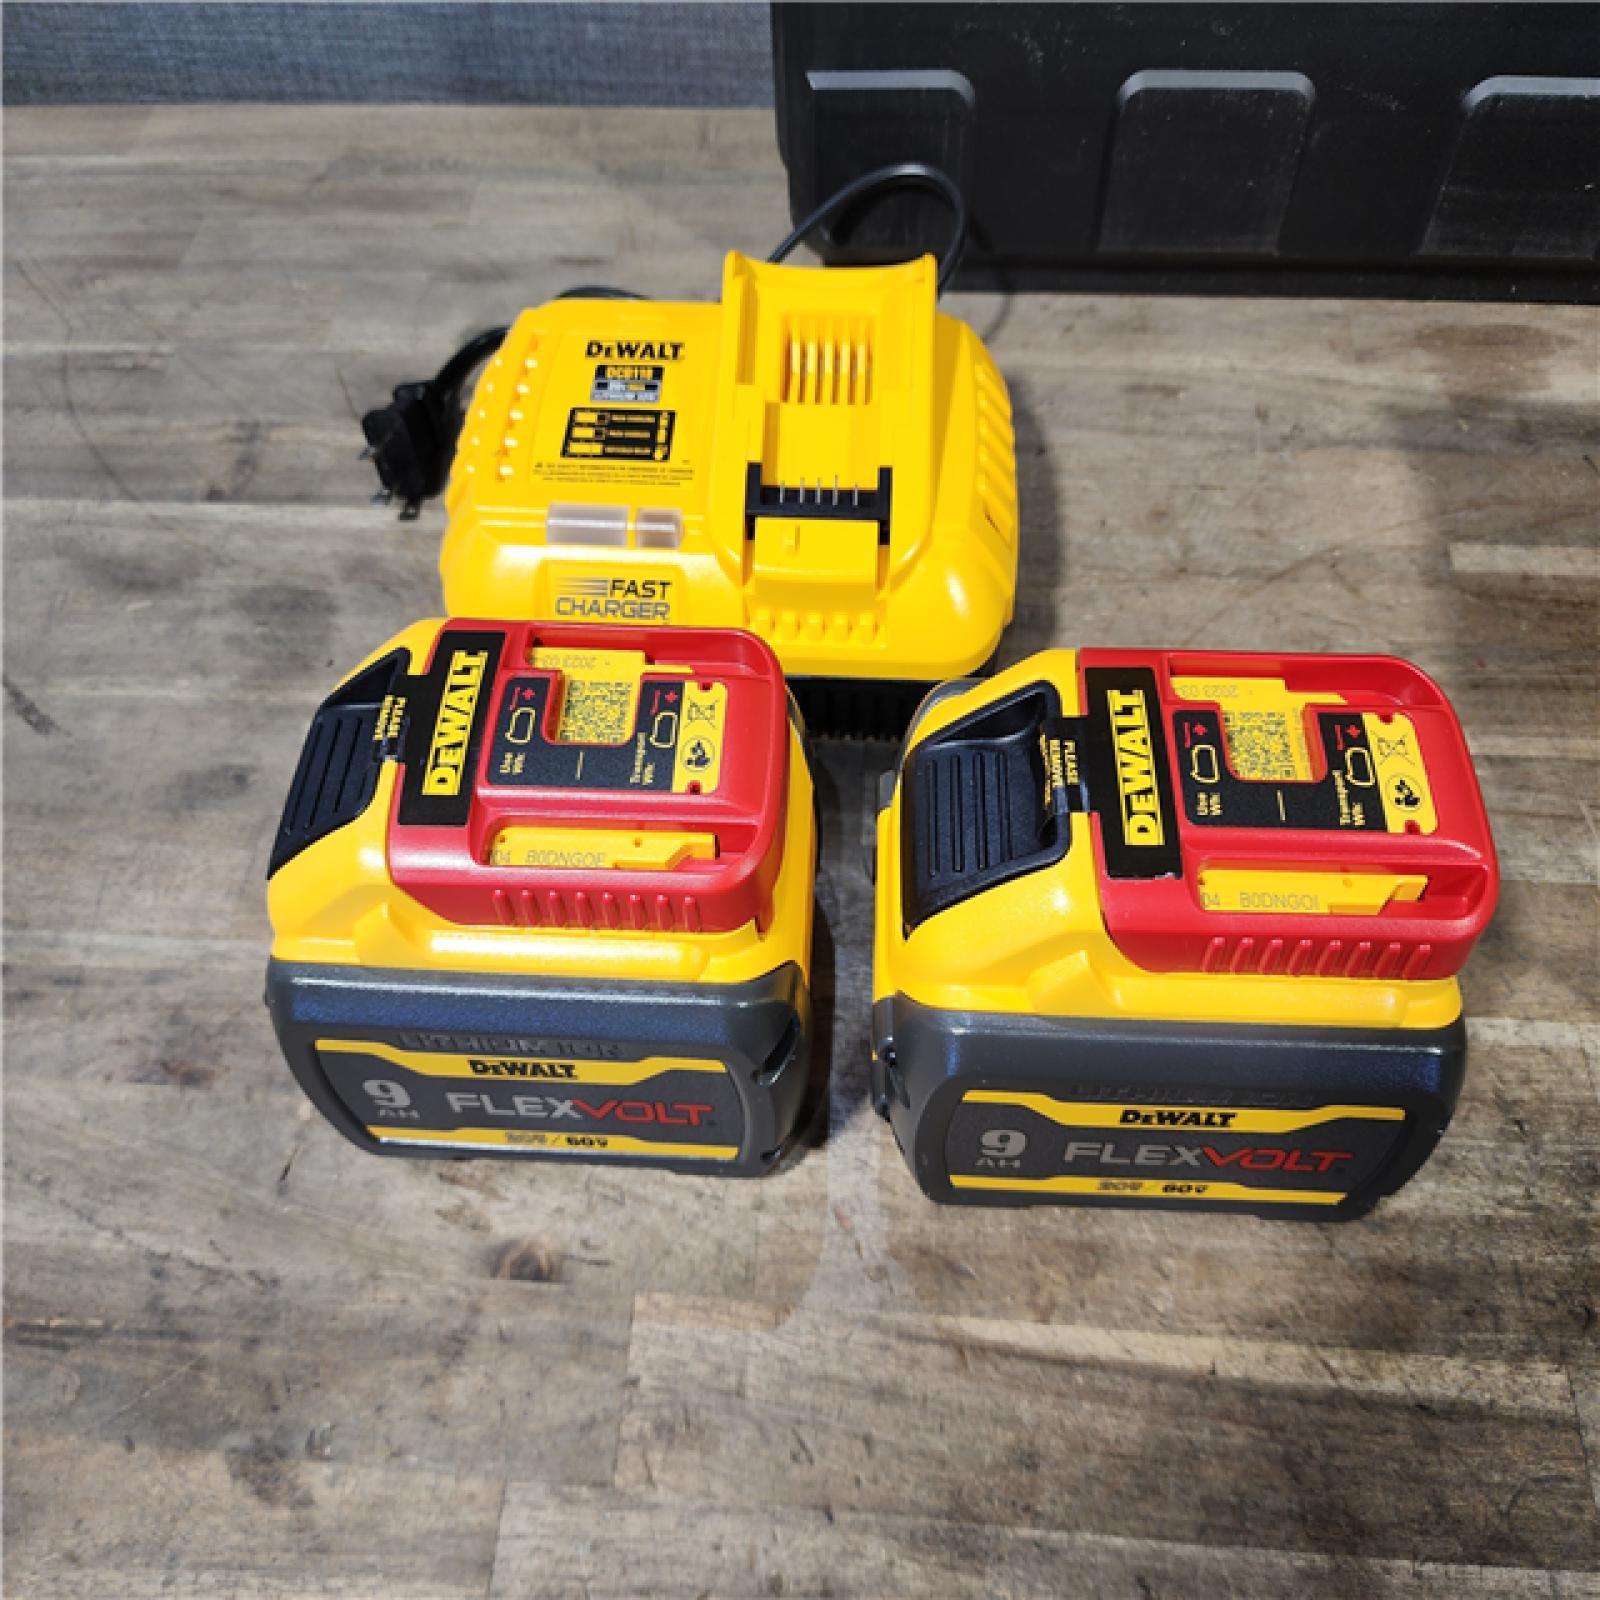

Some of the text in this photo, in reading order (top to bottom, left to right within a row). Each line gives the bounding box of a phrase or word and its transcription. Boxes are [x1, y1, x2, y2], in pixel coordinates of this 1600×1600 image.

[610, 579, 672, 599] FAST
[555, 597, 670, 619] CHARGER
[362, 1079, 411, 1108] 9
[446, 1092, 713, 1127] FLEXVOLT
[980, 1129, 1027, 1157] 9
[1064, 1141, 1353, 1172] FLEXVOLT
